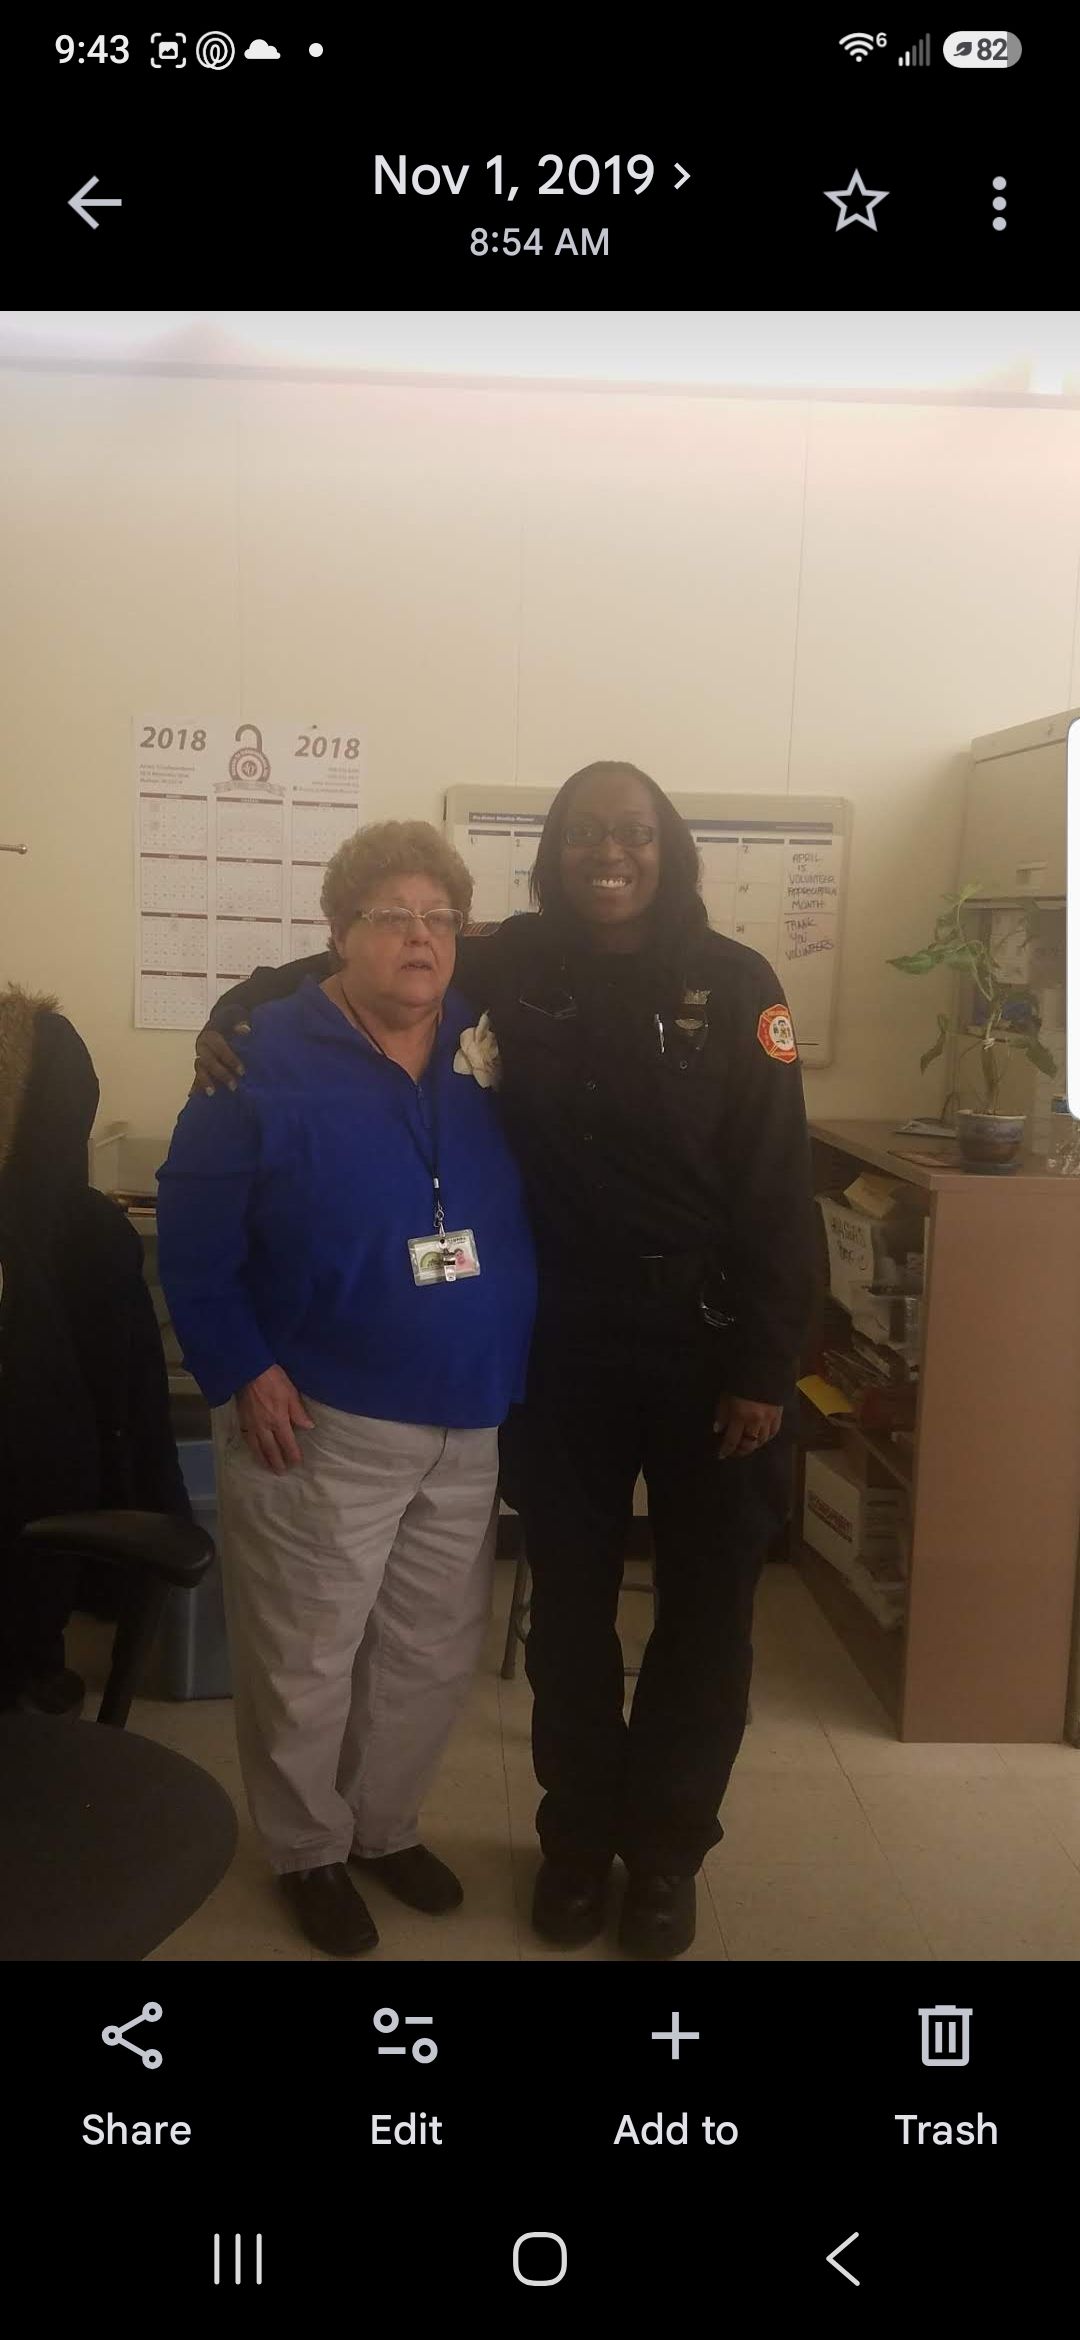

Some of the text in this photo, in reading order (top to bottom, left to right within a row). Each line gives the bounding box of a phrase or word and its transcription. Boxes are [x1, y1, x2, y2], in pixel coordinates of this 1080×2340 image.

[140, 726, 207, 751] 2018
[294, 735, 361, 759] 2018
[792, 853, 823, 864] APRIL
[791, 900, 825, 910] MONTH
